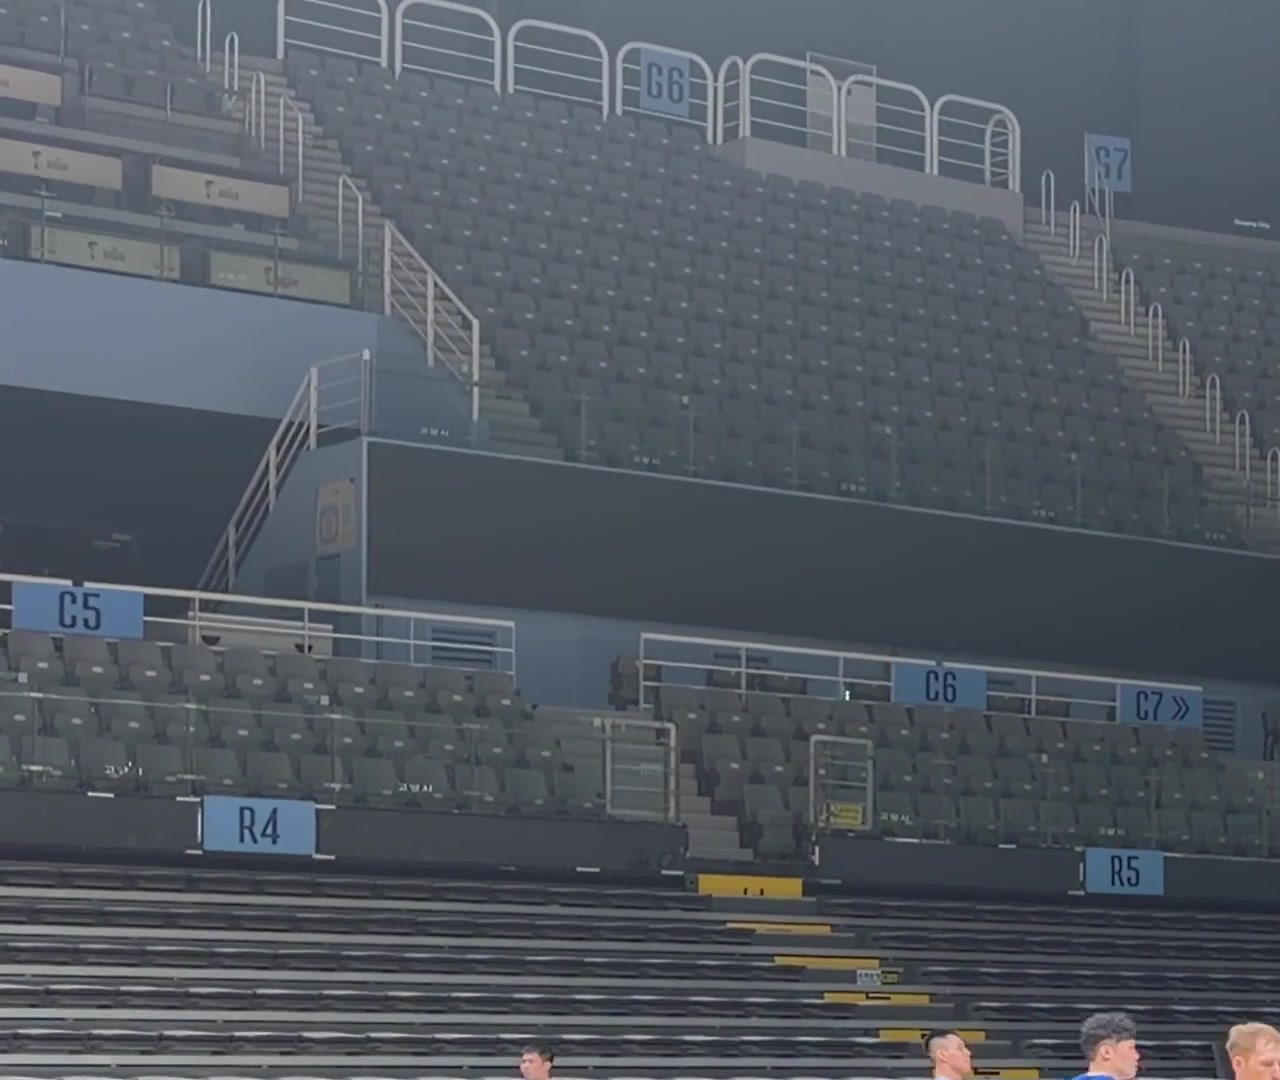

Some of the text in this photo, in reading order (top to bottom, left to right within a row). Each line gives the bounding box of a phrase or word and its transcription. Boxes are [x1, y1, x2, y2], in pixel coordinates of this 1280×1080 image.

[647, 62, 684, 104] G6
[58, 591, 101, 631] C5
[925, 670, 957, 703] C6
[1135, 690, 1163, 722] C7
[239, 806, 281, 845] R4
[1110, 855, 1140, 888] R5
